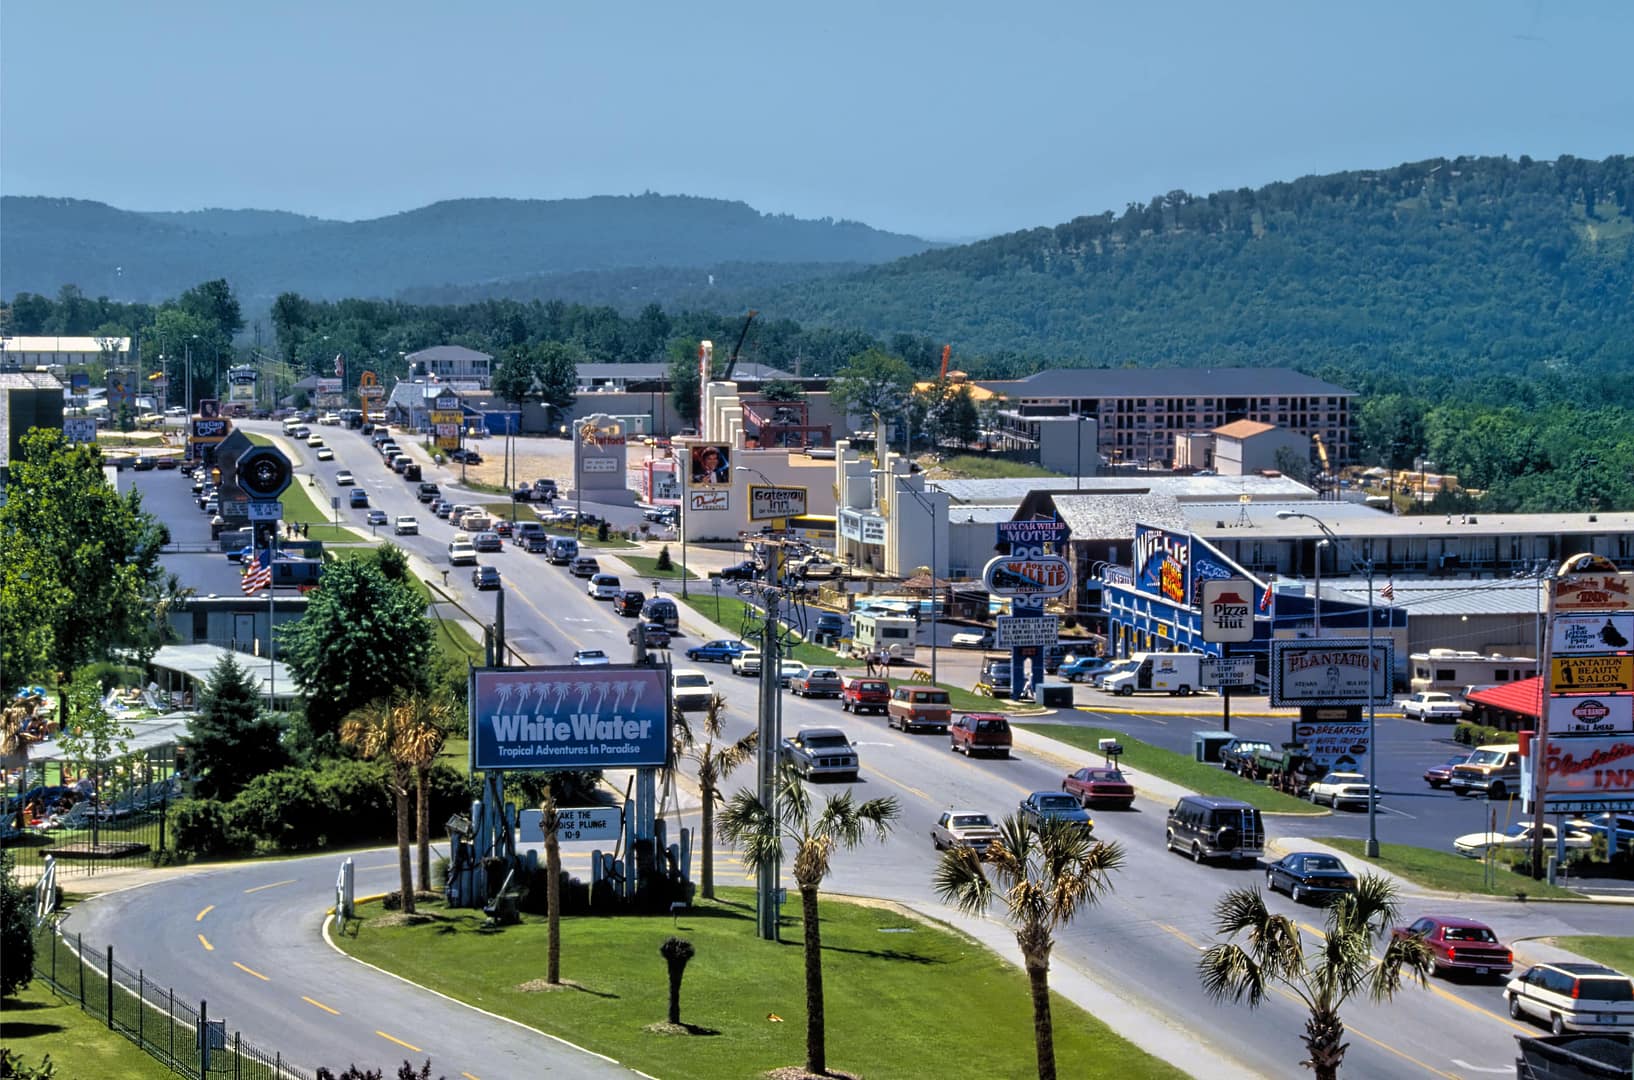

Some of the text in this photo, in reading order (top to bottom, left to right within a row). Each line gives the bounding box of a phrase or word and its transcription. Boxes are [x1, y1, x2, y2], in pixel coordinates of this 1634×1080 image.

[755, 489, 804, 502] Gateway
[1007, 529, 1061, 541] MOTEL
[1136, 530, 1188, 578] WILLIE
[1213, 603, 1248, 618] Pizza
[1212, 617, 1245, 629] Hut
[1288, 652, 1381, 673] PLANTATION
[1560, 658, 1622, 667] PLANTATION
[1578, 666, 1621, 675] BEAUTY
[1578, 674, 1619, 683] SALON
[1315, 725, 1369, 735] BREAKFAST
[499, 743, 641, 758] Tropical Adventures In Paradise
[1315, 745, 1347, 754] MENU
[1580, 801, 1633, 811] REALTY
[558, 811, 592, 819] AKE THE
[578, 820, 607, 829] PLUNGE
